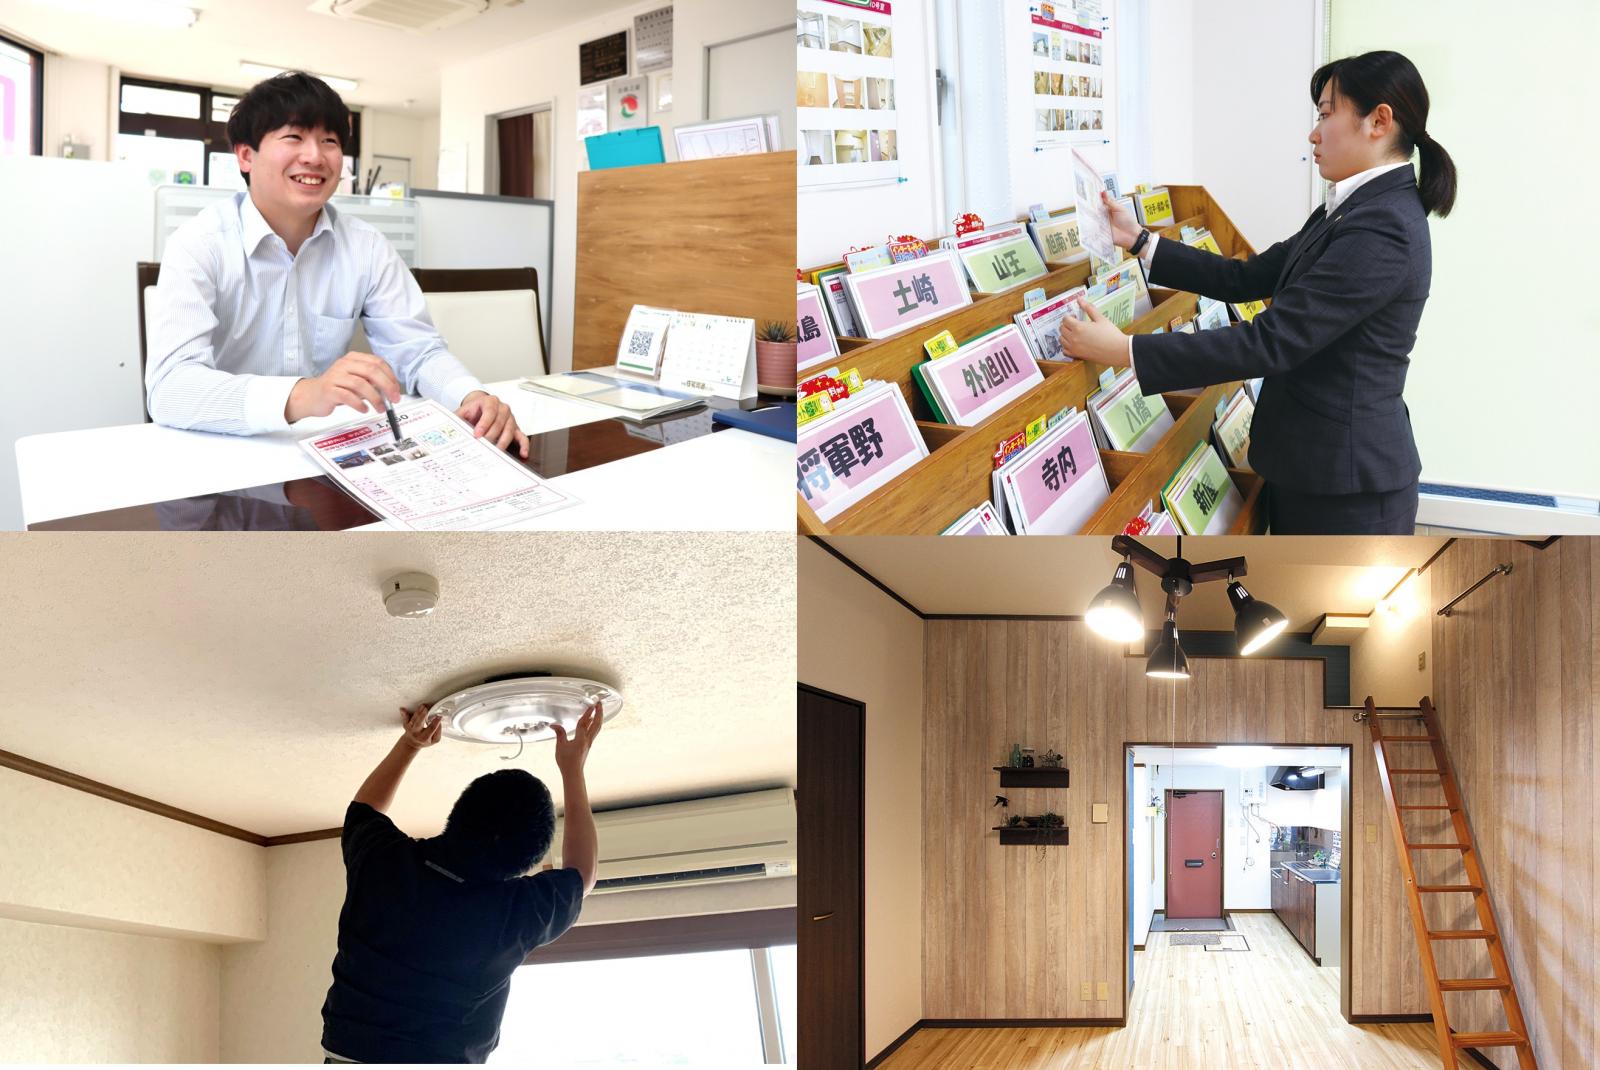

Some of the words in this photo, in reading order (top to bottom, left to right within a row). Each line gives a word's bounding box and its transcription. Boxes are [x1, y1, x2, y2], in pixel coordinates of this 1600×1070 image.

[992, 249, 1026, 281] 山王
[892, 272, 939, 316] 土崎
[961, 346, 1020, 398] 外旭川
[1124, 392, 1152, 434] 八橋
[797, 416, 884, 501] 将軍野
[1041, 444, 1077, 492] 寺内
[1192, 472, 1219, 516] 新屋
